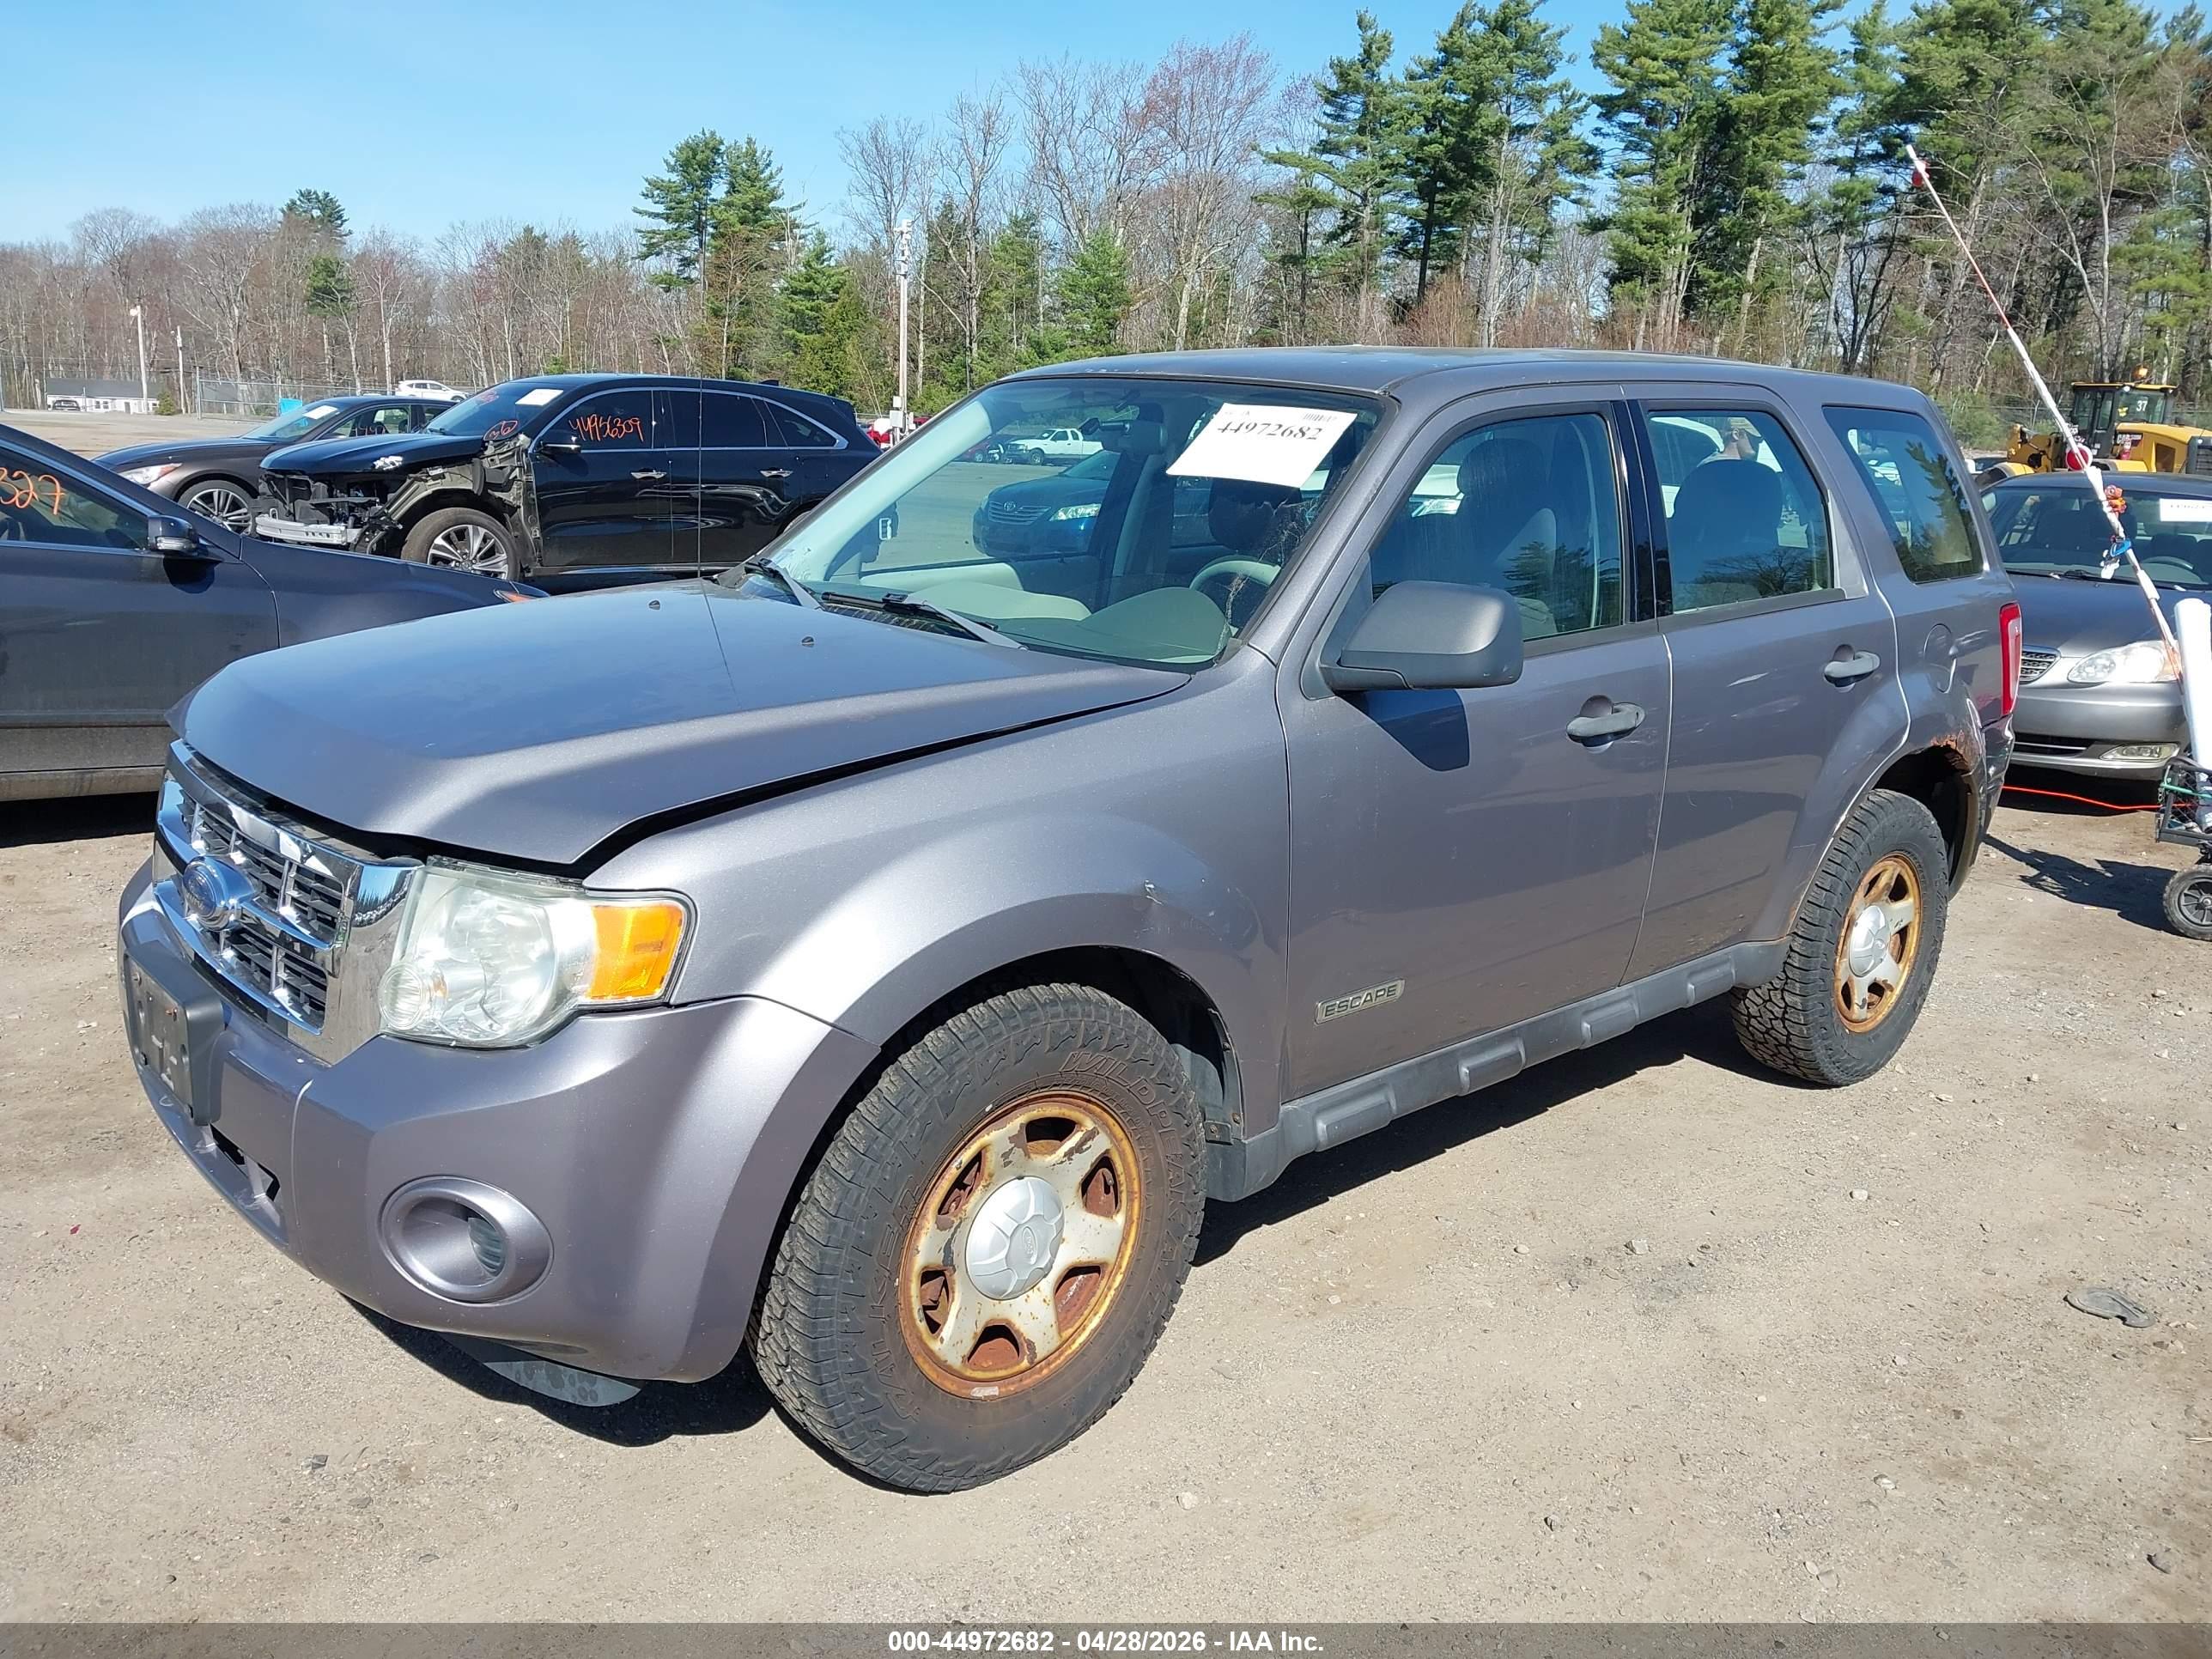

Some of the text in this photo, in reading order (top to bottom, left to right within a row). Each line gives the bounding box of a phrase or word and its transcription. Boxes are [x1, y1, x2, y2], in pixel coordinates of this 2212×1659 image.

[2136, 399, 2148, 412] 37
[568, 413, 644, 442] 44956309
[1217, 421, 1323, 441] 44972682
[1324, 983, 1398, 1018] ESCAPE
